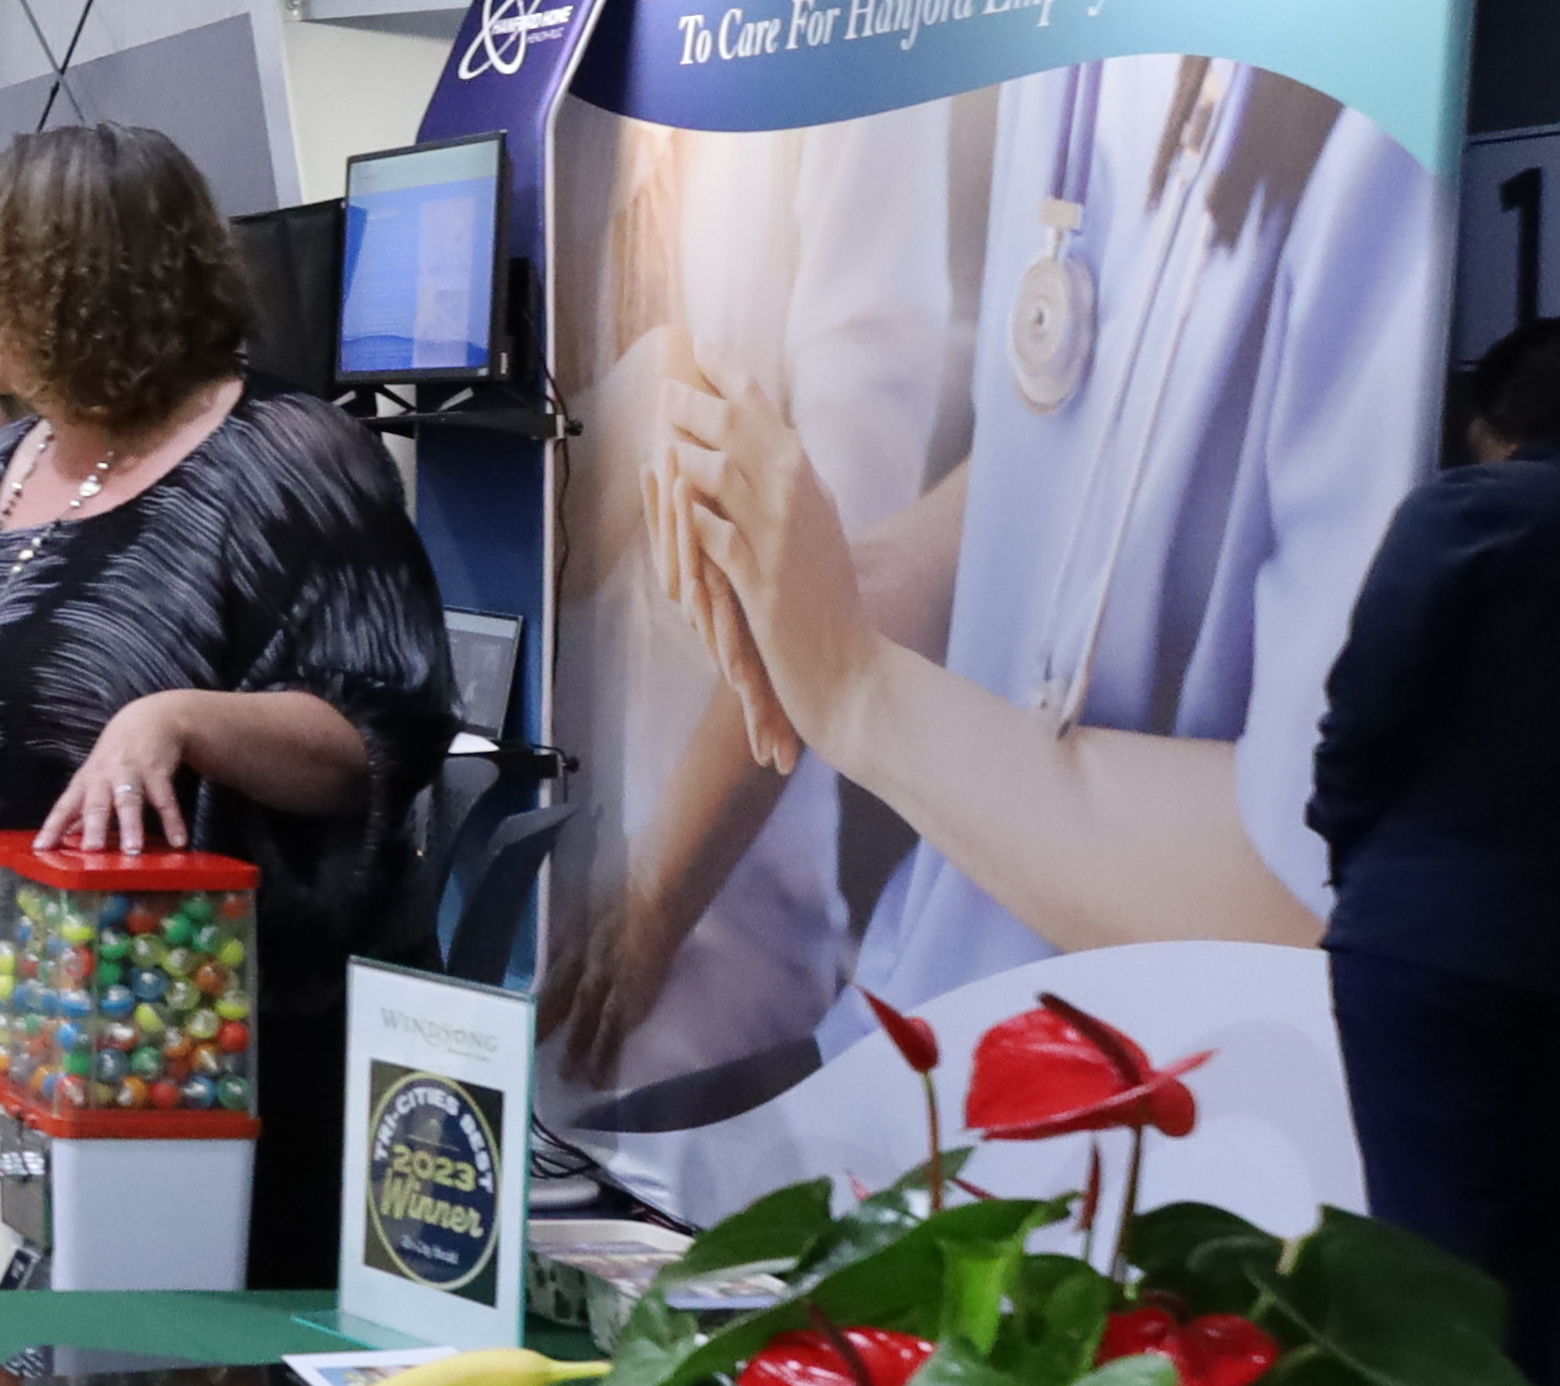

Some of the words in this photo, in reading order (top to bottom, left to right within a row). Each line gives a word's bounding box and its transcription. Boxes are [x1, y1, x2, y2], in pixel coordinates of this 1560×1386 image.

[678, 12, 712, 66] To
[719, 7, 781, 60] Care
[374, 1086, 461, 1161] TRI-CITIES
[460, 1113, 494, 1193] BEST
[391, 1144, 476, 1193] 2023
[381, 1167, 484, 1239] Winner
